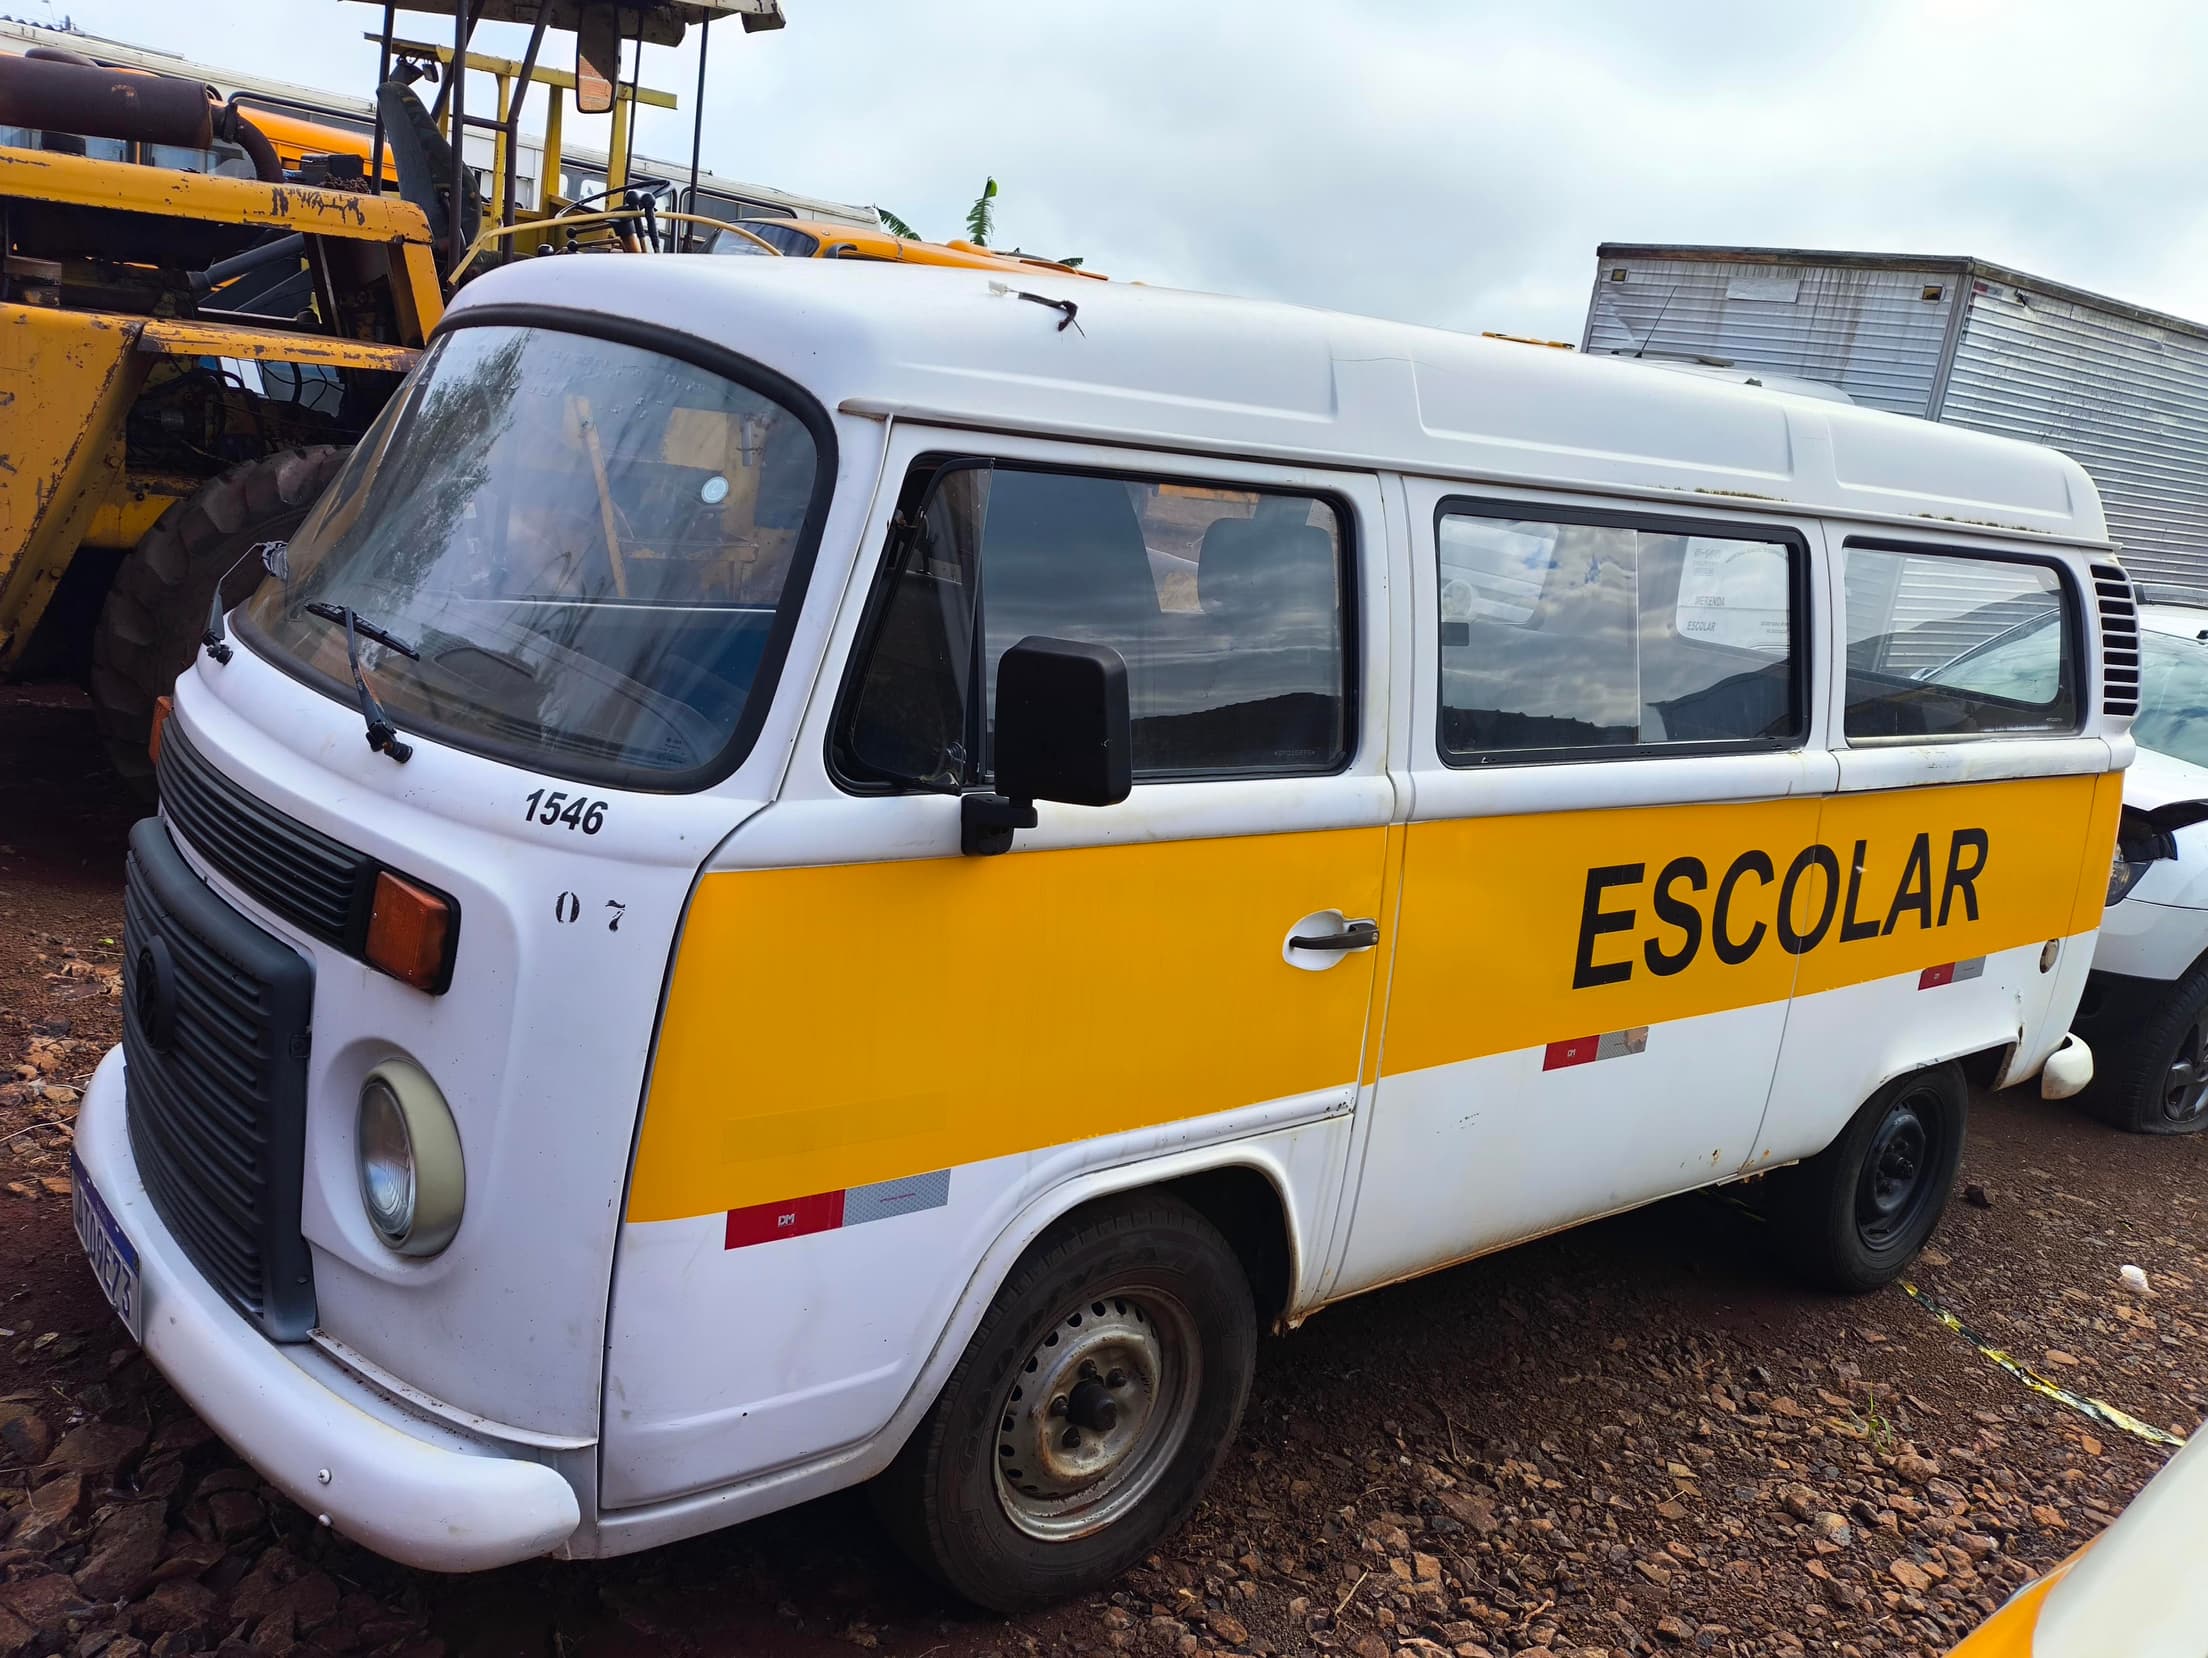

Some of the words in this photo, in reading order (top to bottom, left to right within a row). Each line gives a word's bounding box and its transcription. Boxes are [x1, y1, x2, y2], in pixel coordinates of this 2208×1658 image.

[1687, 620, 1716, 632] ESCOLAR
[525, 788, 609, 835] 1546
[1572, 827, 1989, 989] ESCOLAR
[777, 1213, 796, 1228] DM
